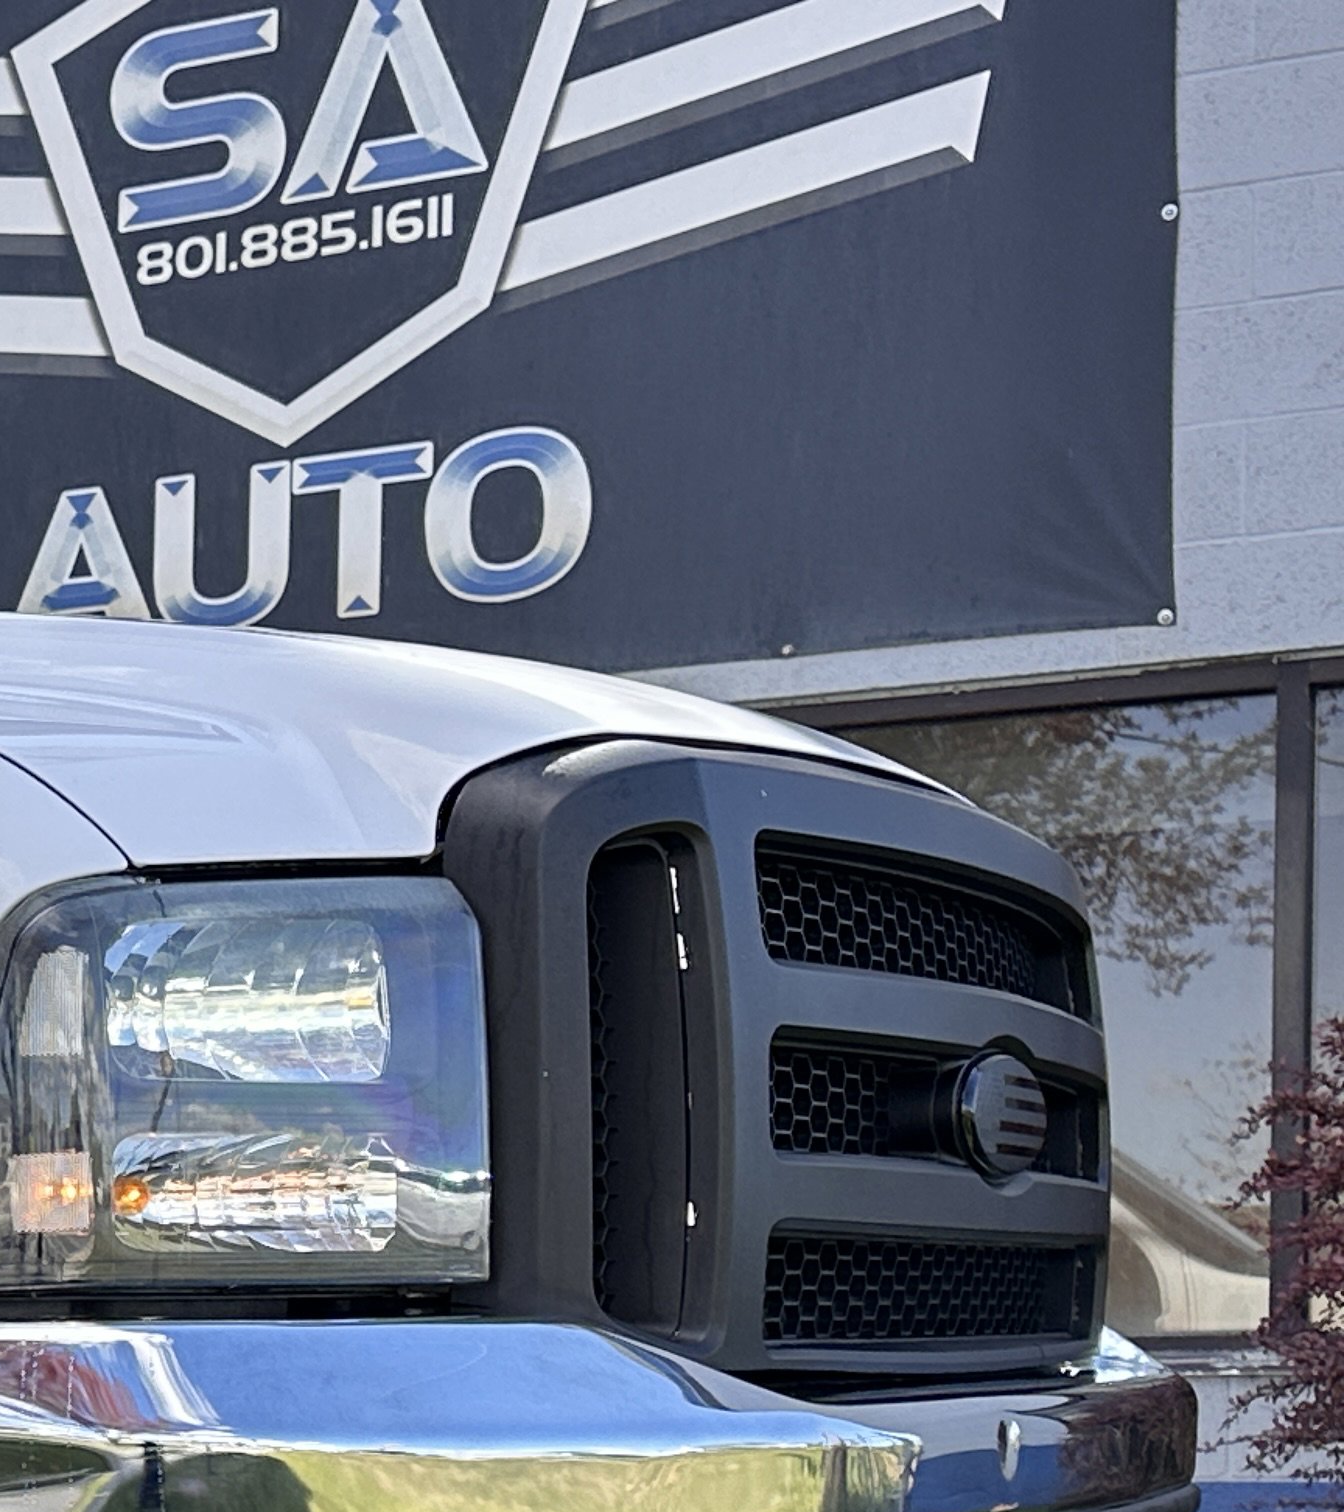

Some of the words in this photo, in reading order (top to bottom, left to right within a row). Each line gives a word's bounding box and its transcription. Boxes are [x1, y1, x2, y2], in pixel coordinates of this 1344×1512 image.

[110, 0, 489, 232] SA
[136, 194, 454, 286] 801.885.1611
[16, 426, 593, 628] AUTO
